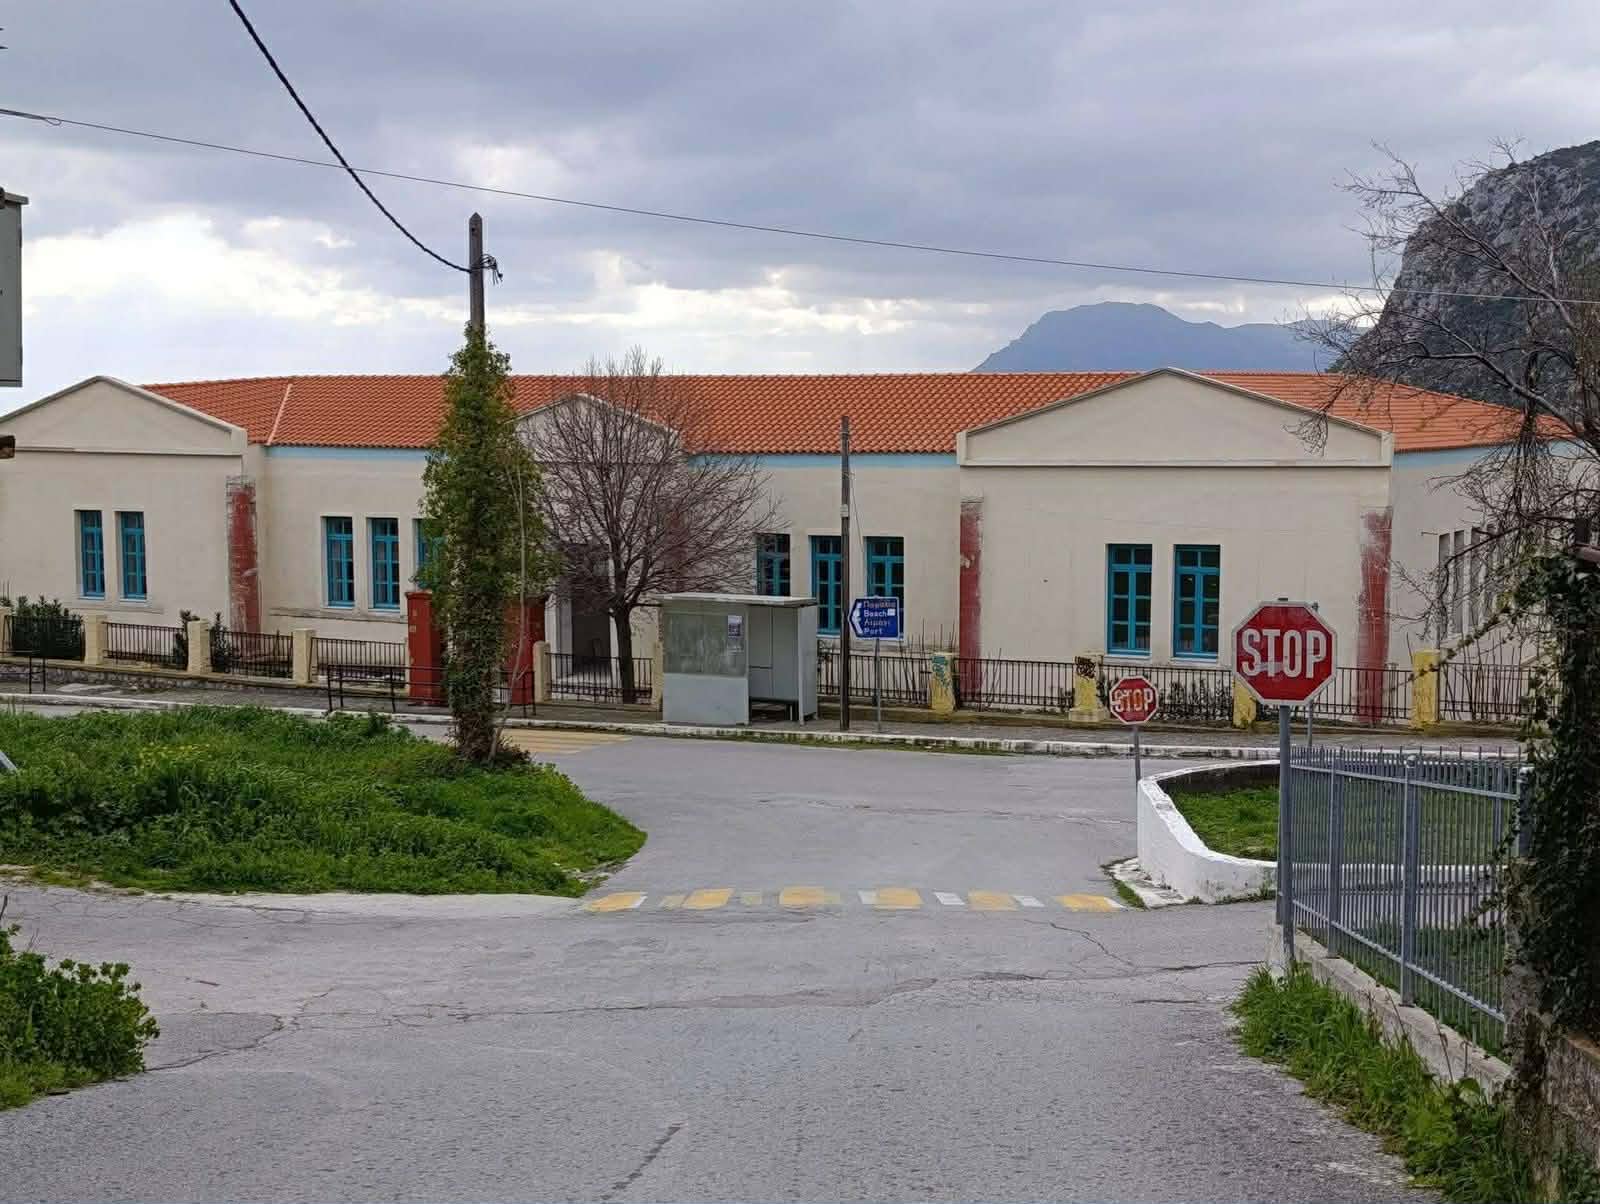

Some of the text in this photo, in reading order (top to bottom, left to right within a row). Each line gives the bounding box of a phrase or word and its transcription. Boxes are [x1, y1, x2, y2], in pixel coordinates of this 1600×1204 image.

[863, 609, 887, 617] Beach
[863, 627, 883, 635] Port
[1240, 628, 1326, 679] STOP
[1113, 688, 1154, 712] STOP
